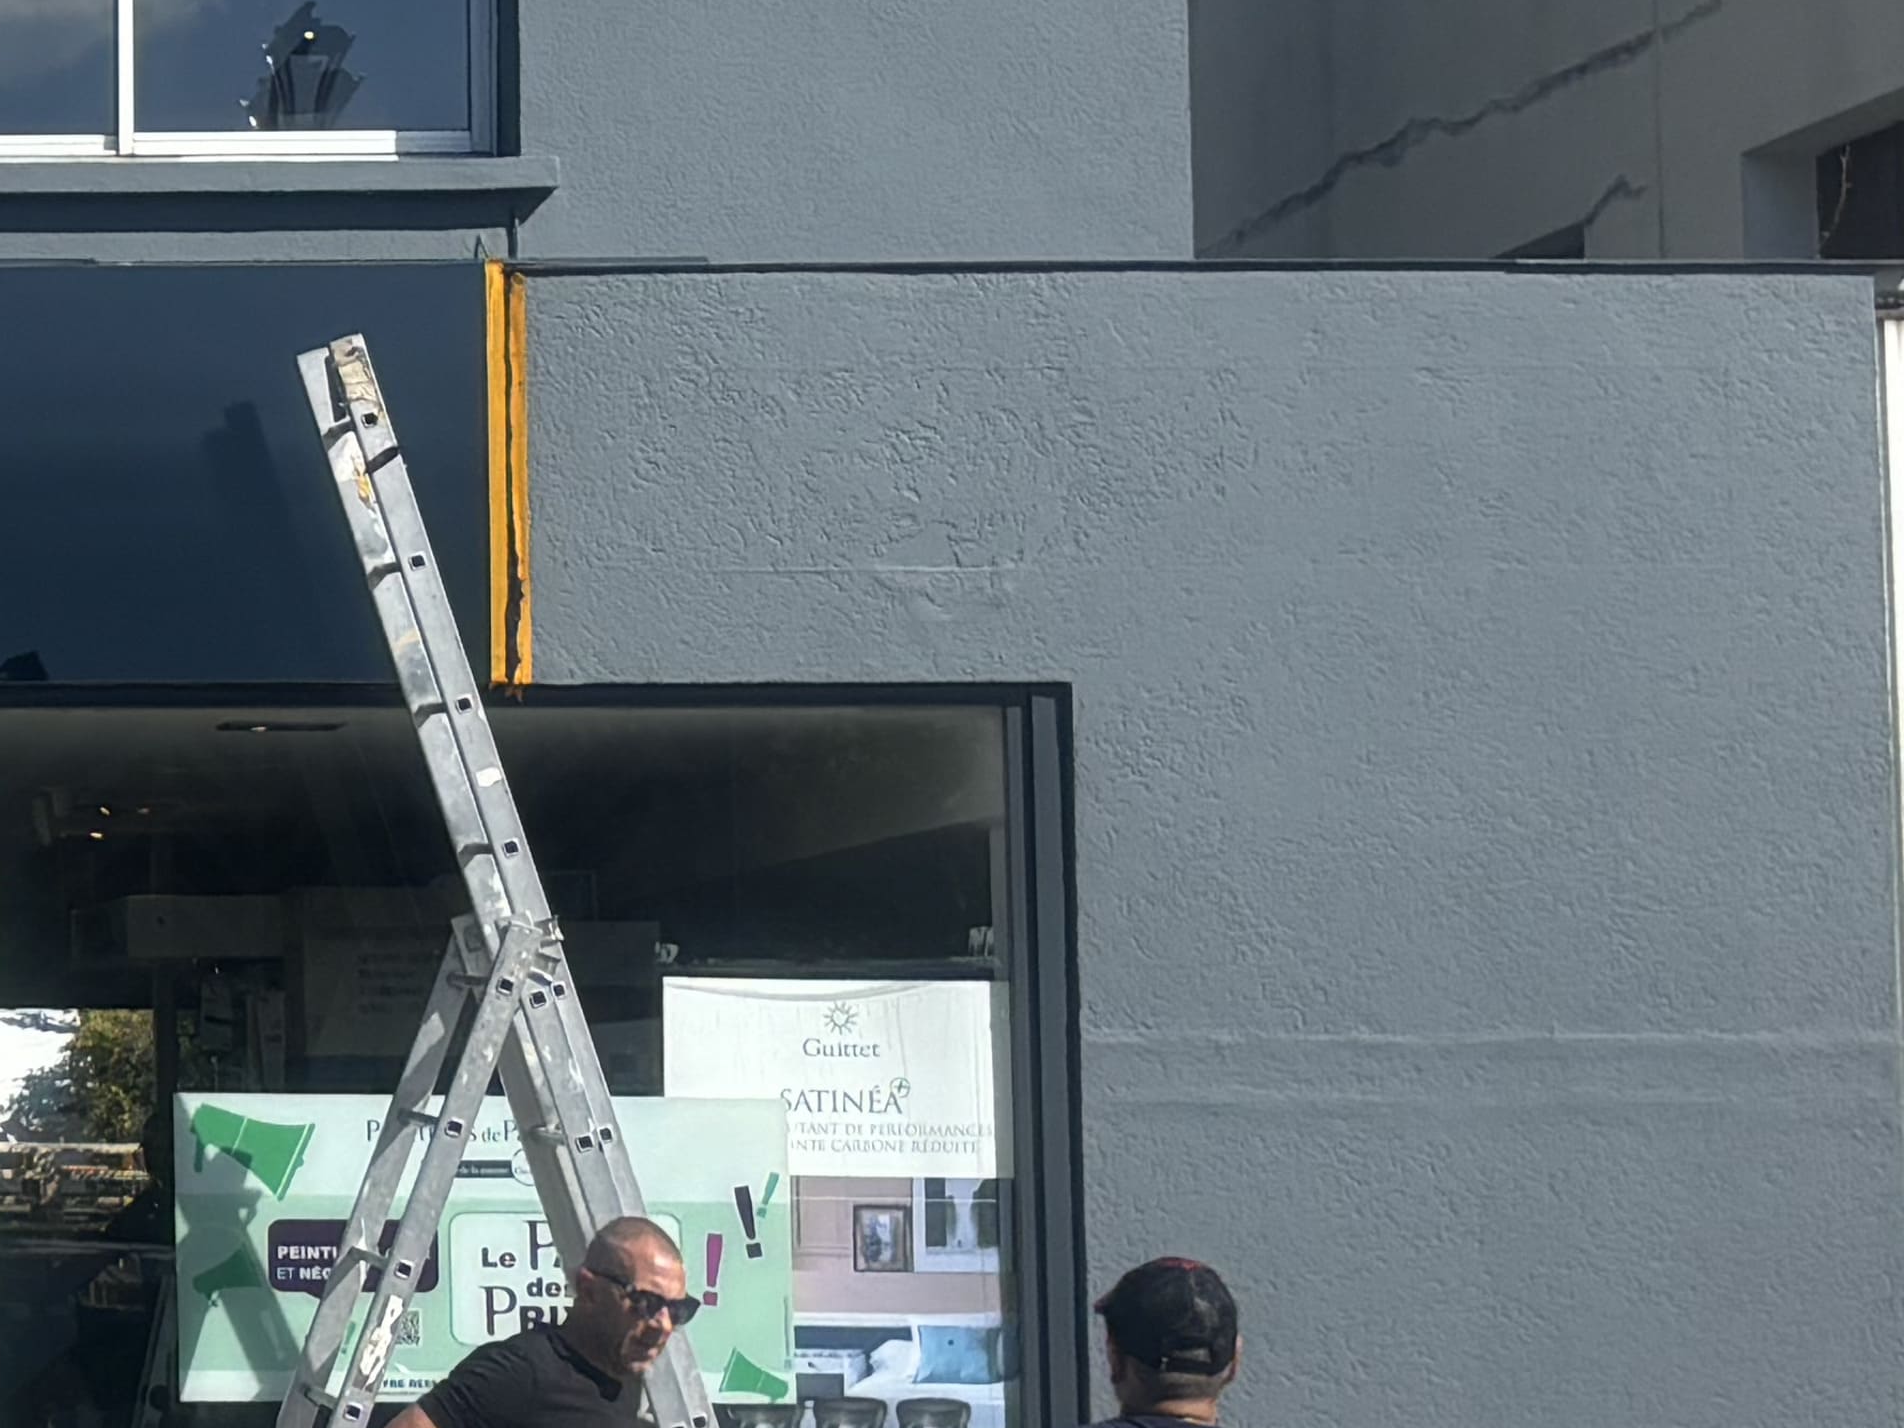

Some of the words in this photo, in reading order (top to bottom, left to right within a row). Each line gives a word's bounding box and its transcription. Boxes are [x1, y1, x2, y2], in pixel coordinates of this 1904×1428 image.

[802, 1038, 881, 1058] Guittet
[780, 1084, 903, 1114] SATINÉA
[481, 1246, 517, 1269] Le
[276, 1267, 295, 1280] ET
